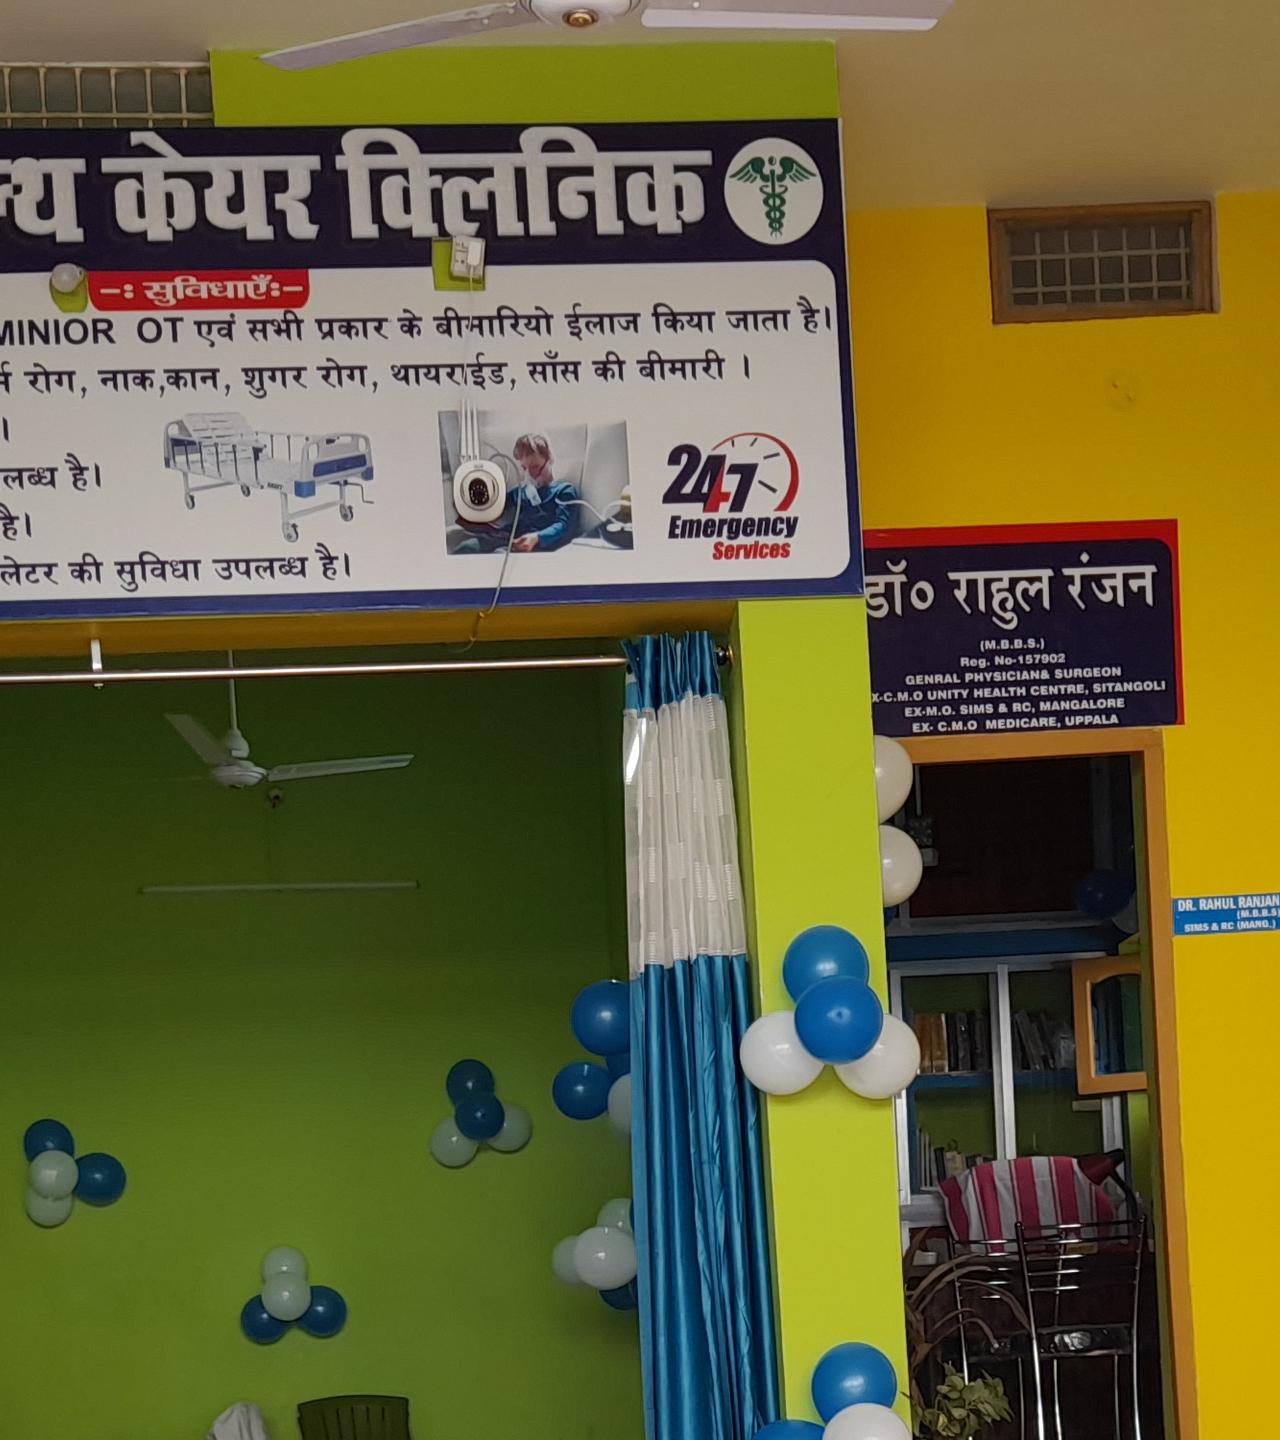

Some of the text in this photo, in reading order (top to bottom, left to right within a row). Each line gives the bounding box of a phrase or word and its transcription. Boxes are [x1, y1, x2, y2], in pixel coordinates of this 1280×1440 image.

[102, 132, 320, 240] केयर
[336, 127, 711, 239] क्लिनिक
[137, 317, 184, 343] OT
[194, 313, 235, 347] एवं
[246, 309, 305, 342] सभी
[315, 318, 388, 339] प्रकार
[397, 309, 422, 338] के
[565, 303, 641, 340] ईलाज
[651, 303, 715, 333] किया
[726, 310, 790, 331] जाता
[24, 363, 86, 398] रोग,
[241, 367, 307, 398] शुगर
[317, 358, 377, 392] रोग,
[592, 351, 626, 381] की
[636, 349, 725, 380] बीमारी
[668, 515, 798, 540] Emergency
[712, 541, 791, 560] Services
[68, 553, 103, 583] की
[114, 551, 201, 592] सुविधा
[212, 557, 308, 579] उपलब्ध
[947, 568, 1055, 630] राहुल
[1062, 552, 1158, 610] रंजन
[980, 639, 1045, 651] (M.B.B.S.)
[960, 653, 1065, 668] Reg. No-157902
[905, 673, 960, 685] GENRAL
[1055, 667, 1122, 679] SURGEON
[872, 680, 1166, 703] X-C.M.O UNITY HEALTH CENTRE, SITANGOLI
[959, 703, 993, 714] SIMS
[998, 703, 1009, 714] &
[1012, 702, 1036, 714] RC,
[1040, 698, 1125, 711] MANGALORE
[938, 720, 977, 731] C.M.O
[986, 717, 1062, 729] MEDICARE,
[1065, 714, 1119, 727] UPPALA
[1178, 895, 1280, 911] DR. RAHUL RANJAN
[1221, 922, 1233, 930] RC
